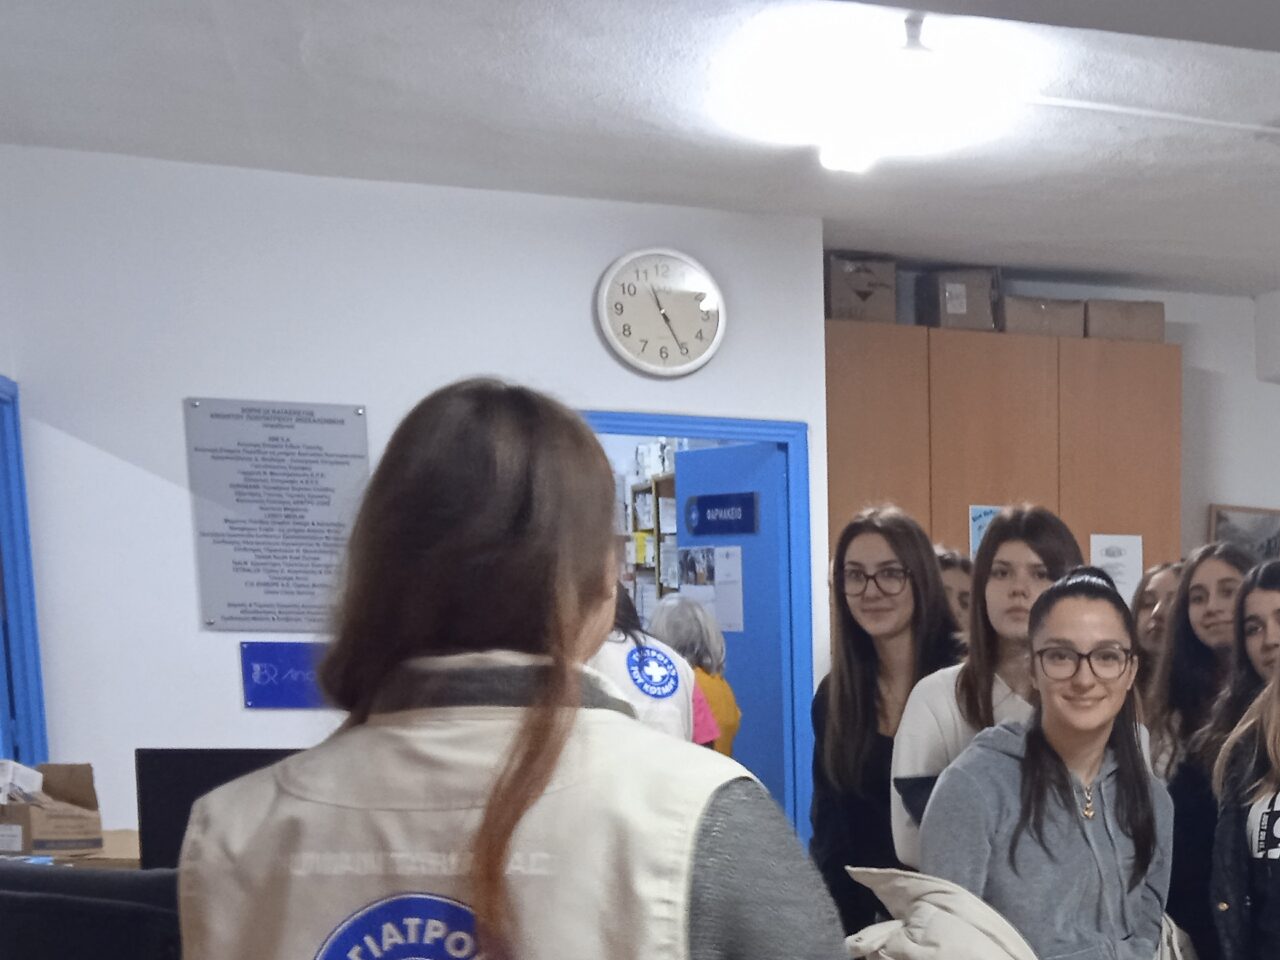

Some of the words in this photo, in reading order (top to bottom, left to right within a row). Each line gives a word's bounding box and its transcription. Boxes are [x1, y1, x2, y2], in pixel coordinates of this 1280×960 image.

[635, 269, 649, 282] 11
[653, 264, 670, 277] 12
[620, 282, 637, 297] 10
[614, 302, 624, 316] 9
[622, 324, 632, 338] 8
[694, 328, 704, 342] 4
[639, 339, 649, 353] 7
[659, 346, 669, 360] 6
